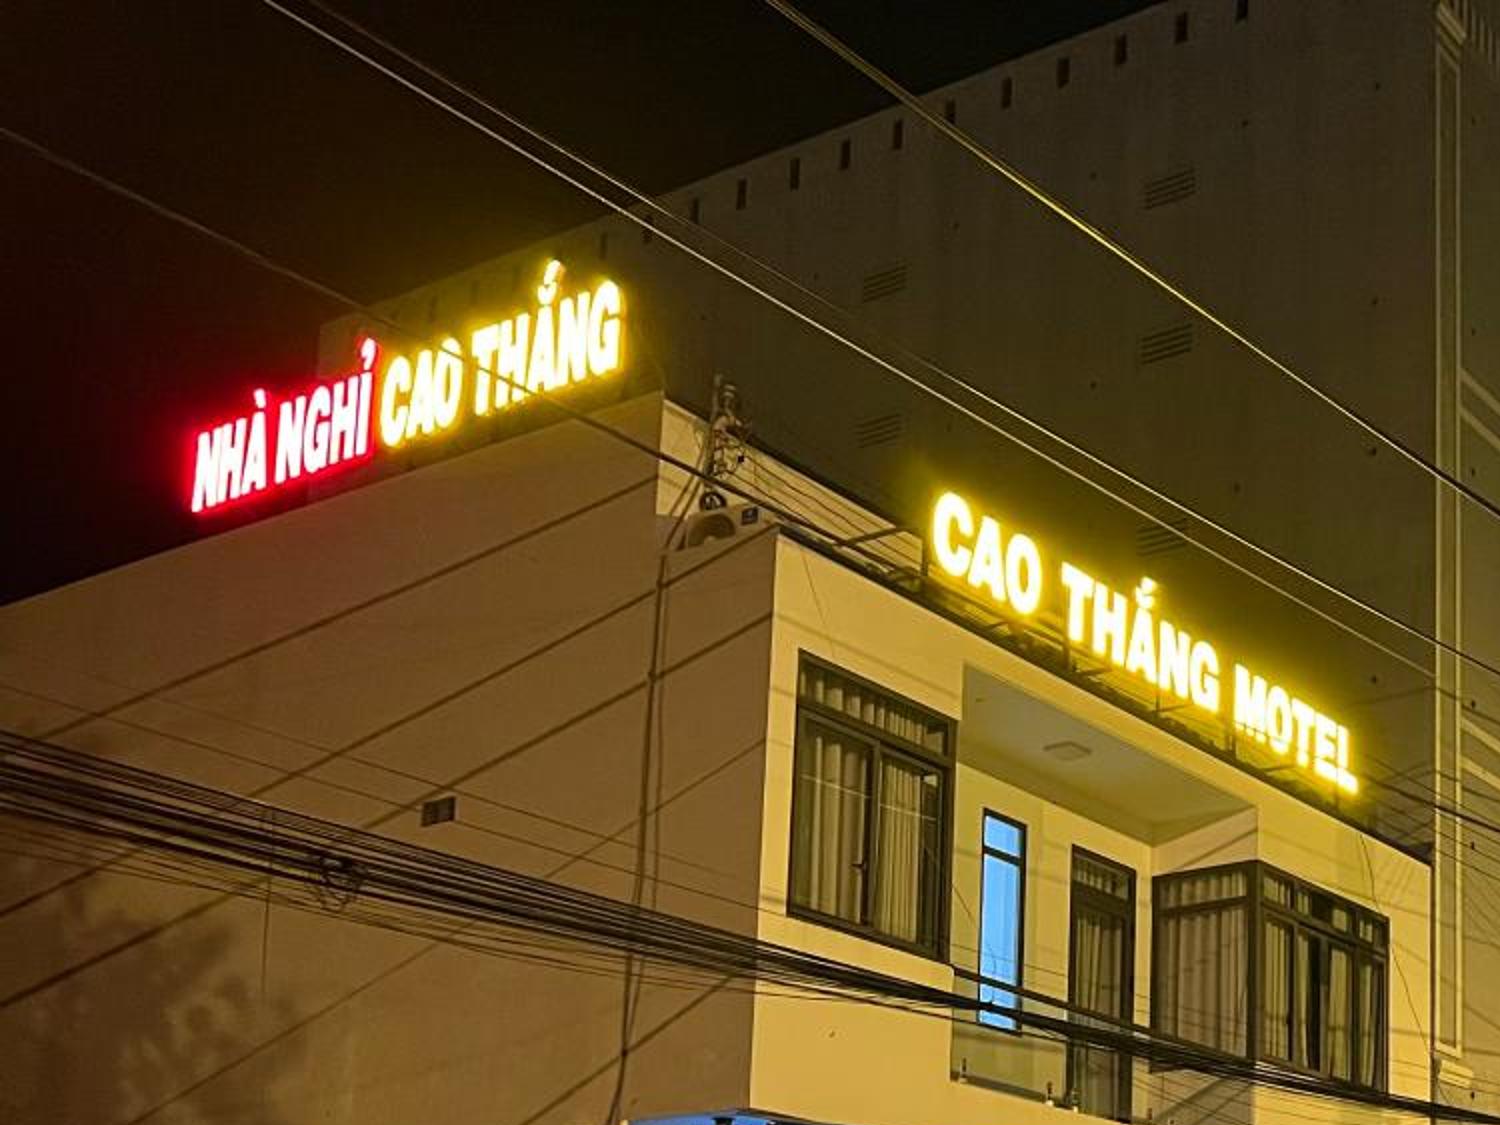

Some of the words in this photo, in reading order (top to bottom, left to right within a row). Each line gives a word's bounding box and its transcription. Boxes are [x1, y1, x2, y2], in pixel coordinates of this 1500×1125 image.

[191, 387, 267, 513] NHÀ
[274, 337, 379, 484] NGHỈ
[380, 337, 464, 447] CAO
[932, 491, 1042, 616] CAO
[1061, 561, 1221, 714] THẮNG
[1234, 663, 1359, 796] MOTEL
